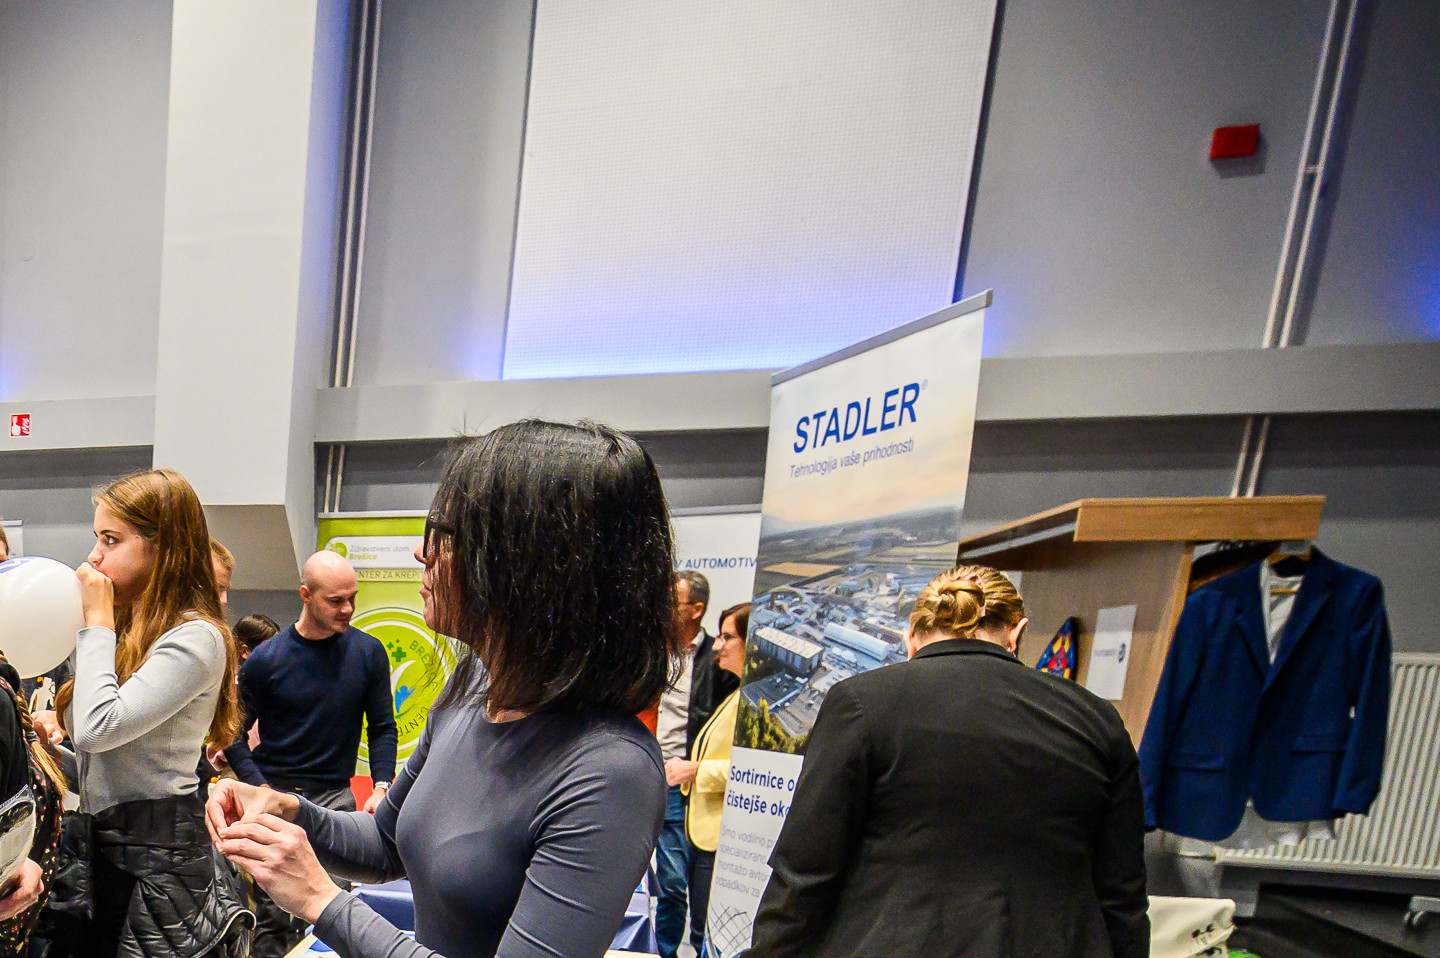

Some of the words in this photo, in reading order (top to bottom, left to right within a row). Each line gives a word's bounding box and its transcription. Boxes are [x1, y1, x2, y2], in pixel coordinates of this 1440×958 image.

[793, 382, 921, 454] STADLER
[790, 455, 838, 479] Tehnologija
[862, 436, 915, 466] prihodnosti
[356, 570, 380, 579] NTER
[685, 557, 757, 569] AUTOMOTIV
[730, 766, 784, 790] Sortirnice
[726, 790, 767, 815] čistejše
